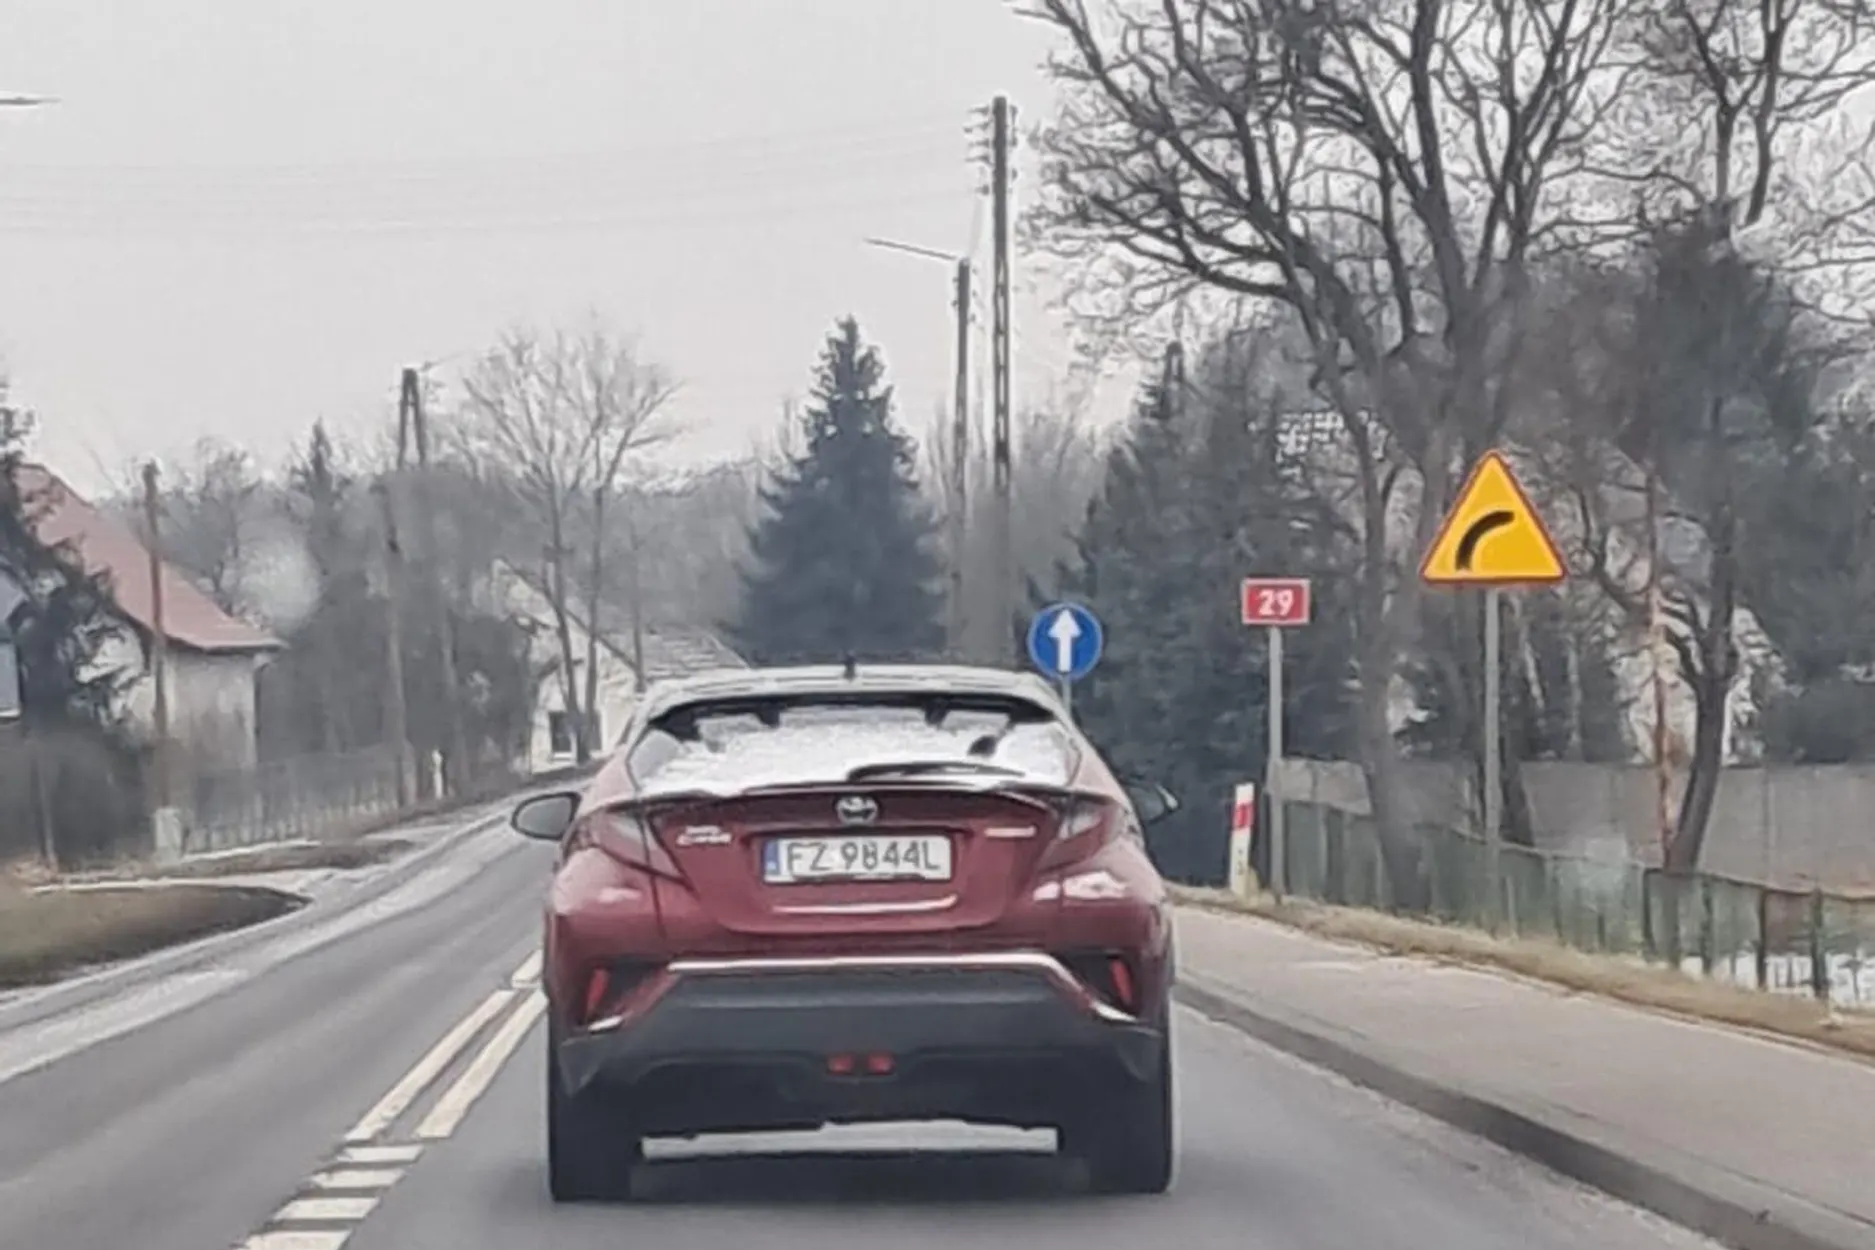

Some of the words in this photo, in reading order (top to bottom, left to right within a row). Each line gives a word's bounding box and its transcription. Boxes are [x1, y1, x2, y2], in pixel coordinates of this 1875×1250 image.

[1258, 589, 1294, 616] 29
[787, 842, 831, 872] FZ
[840, 840, 940, 870] 9844L
